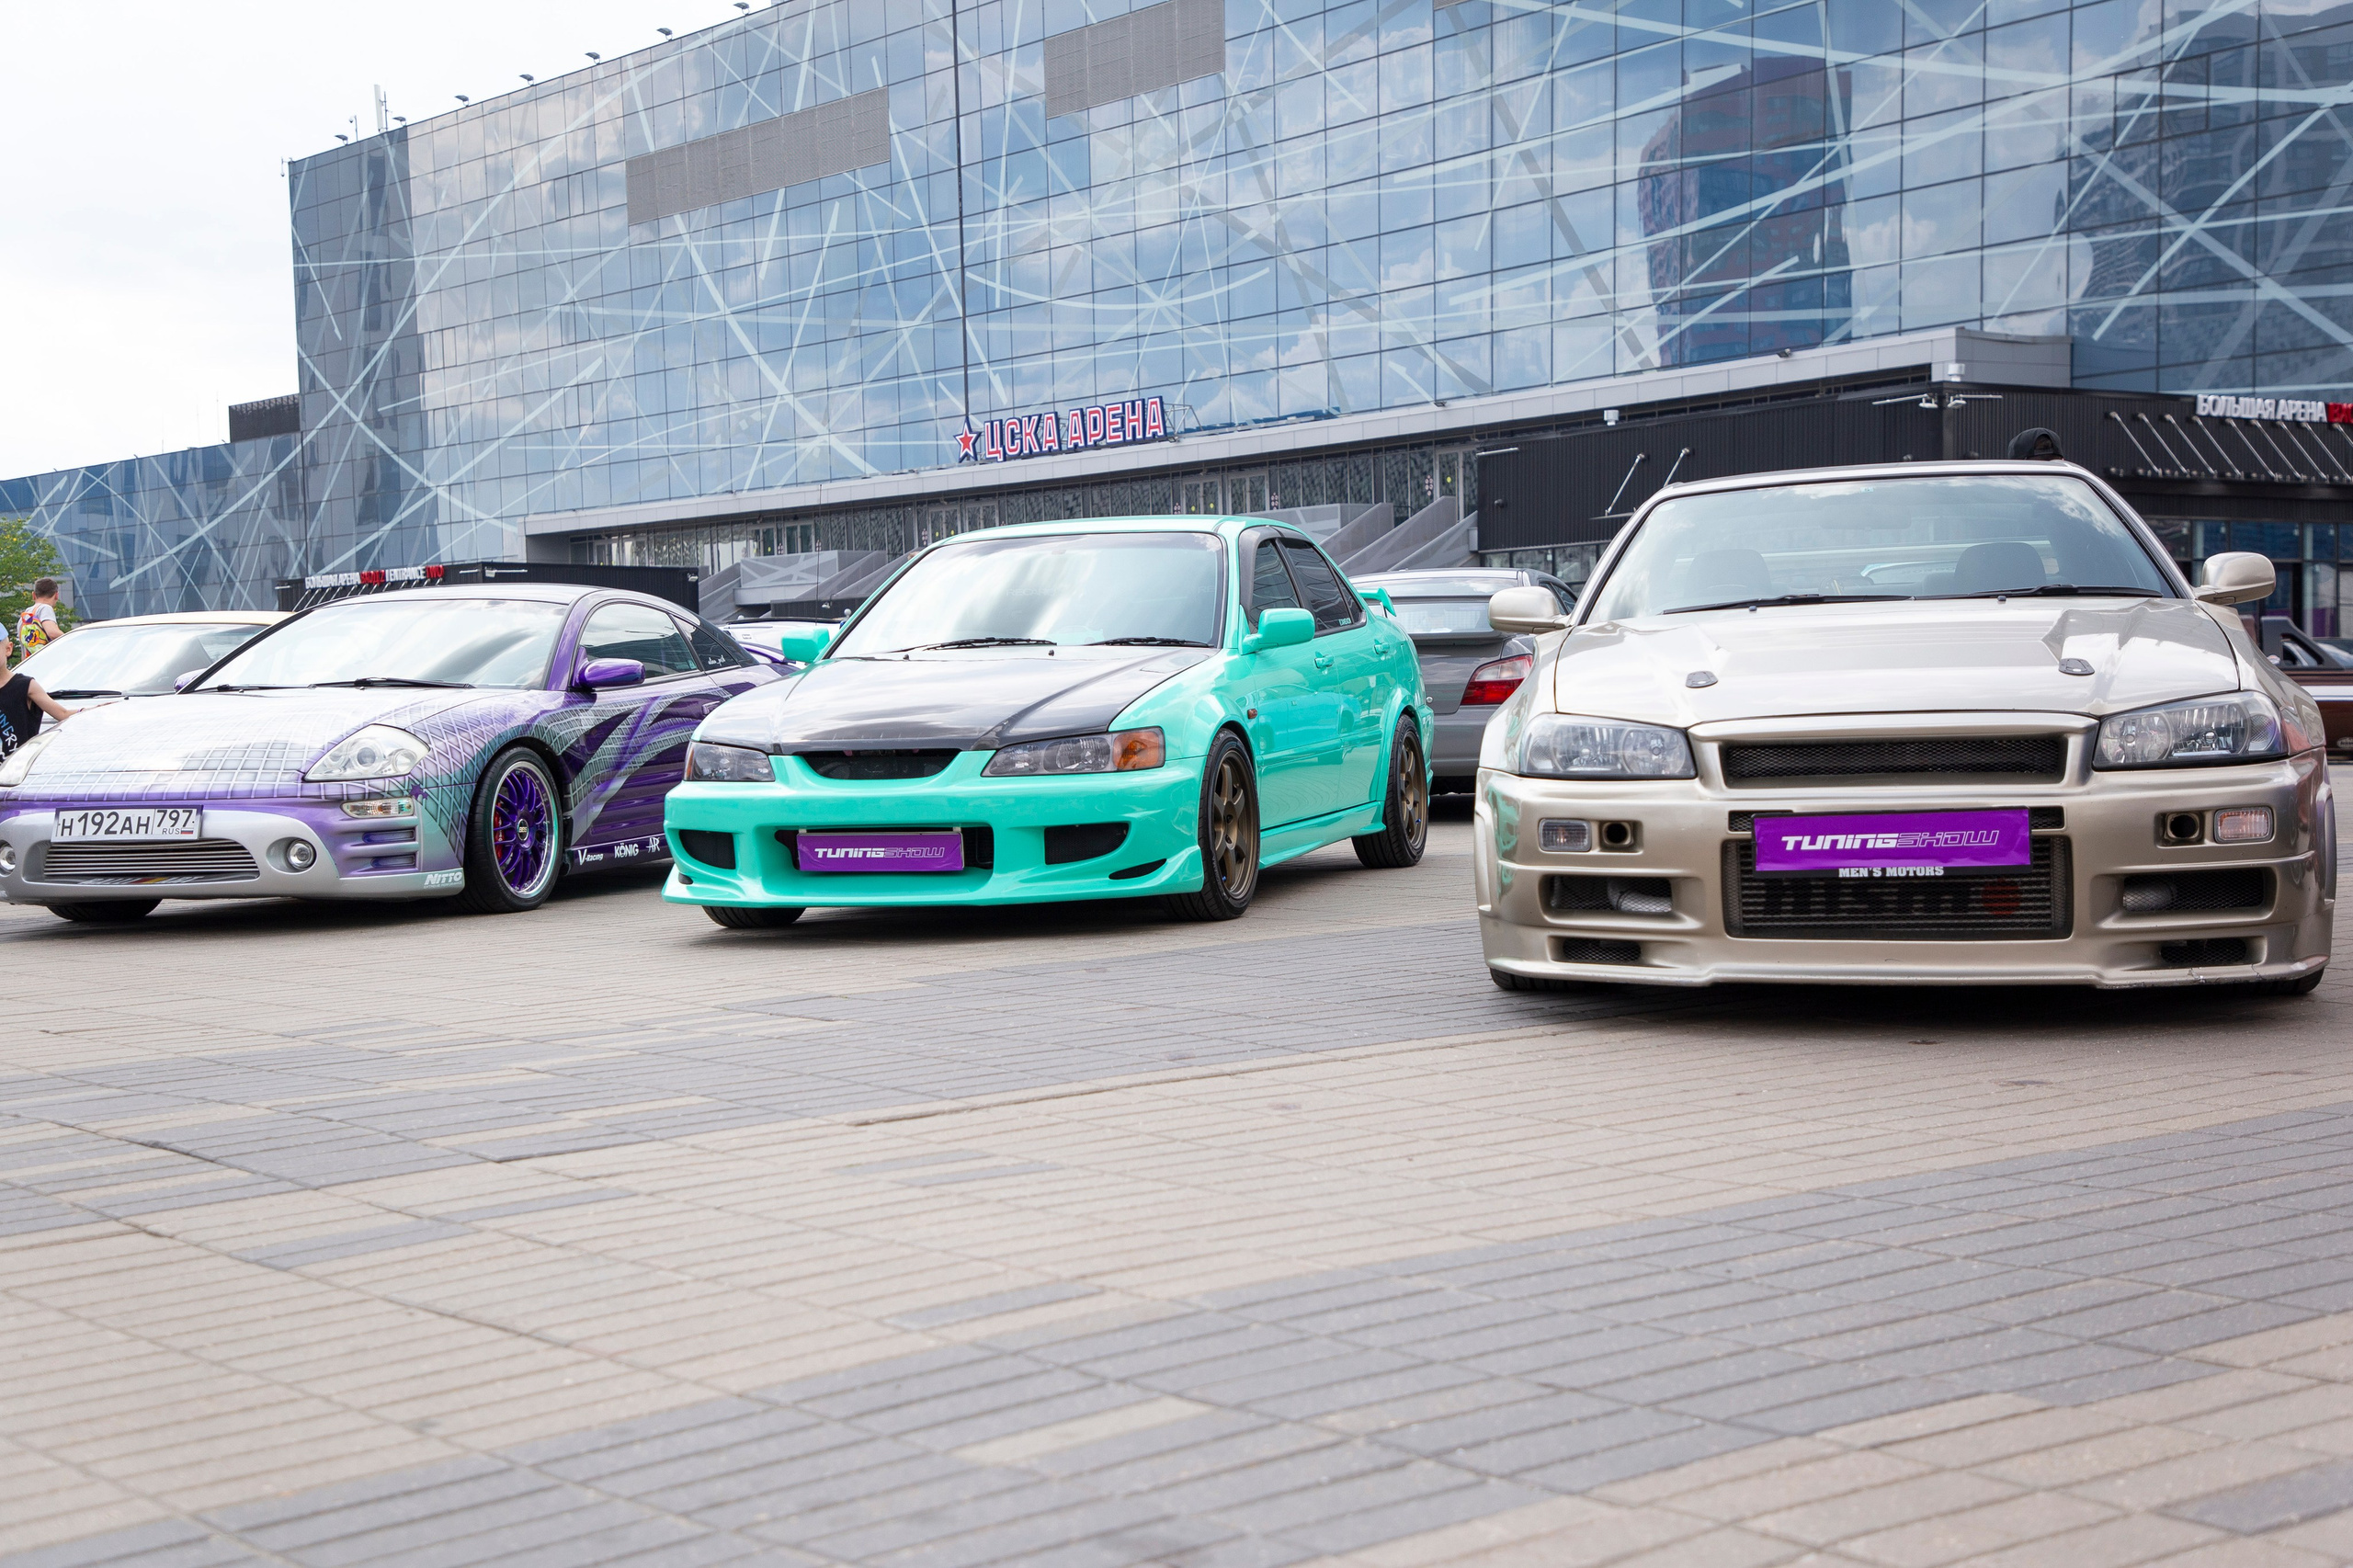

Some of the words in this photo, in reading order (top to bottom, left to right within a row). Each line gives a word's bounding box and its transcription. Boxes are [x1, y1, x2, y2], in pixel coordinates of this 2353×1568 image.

[2196, 393, 2276, 420] БОЛЬШАЯ
[2277, 399, 2328, 423] АРЕНА
[983, 411, 1062, 462] ЦСКА
[1066, 395, 1167, 449] АРЕНА
[305, 574, 337, 589] БОЛЬШАЯ
[338, 573, 361, 586] АРЕНА
[390, 566, 426, 582] ENTRANCE
[426, 564, 444, 579] TWO
[156, 809, 193, 828] 797
[614, 842, 639, 858] KÖNIG
[424, 871, 462, 885] NITTO
[1838, 867, 1882, 878] MEN'S
[1885, 866, 1944, 877] MOTORS
